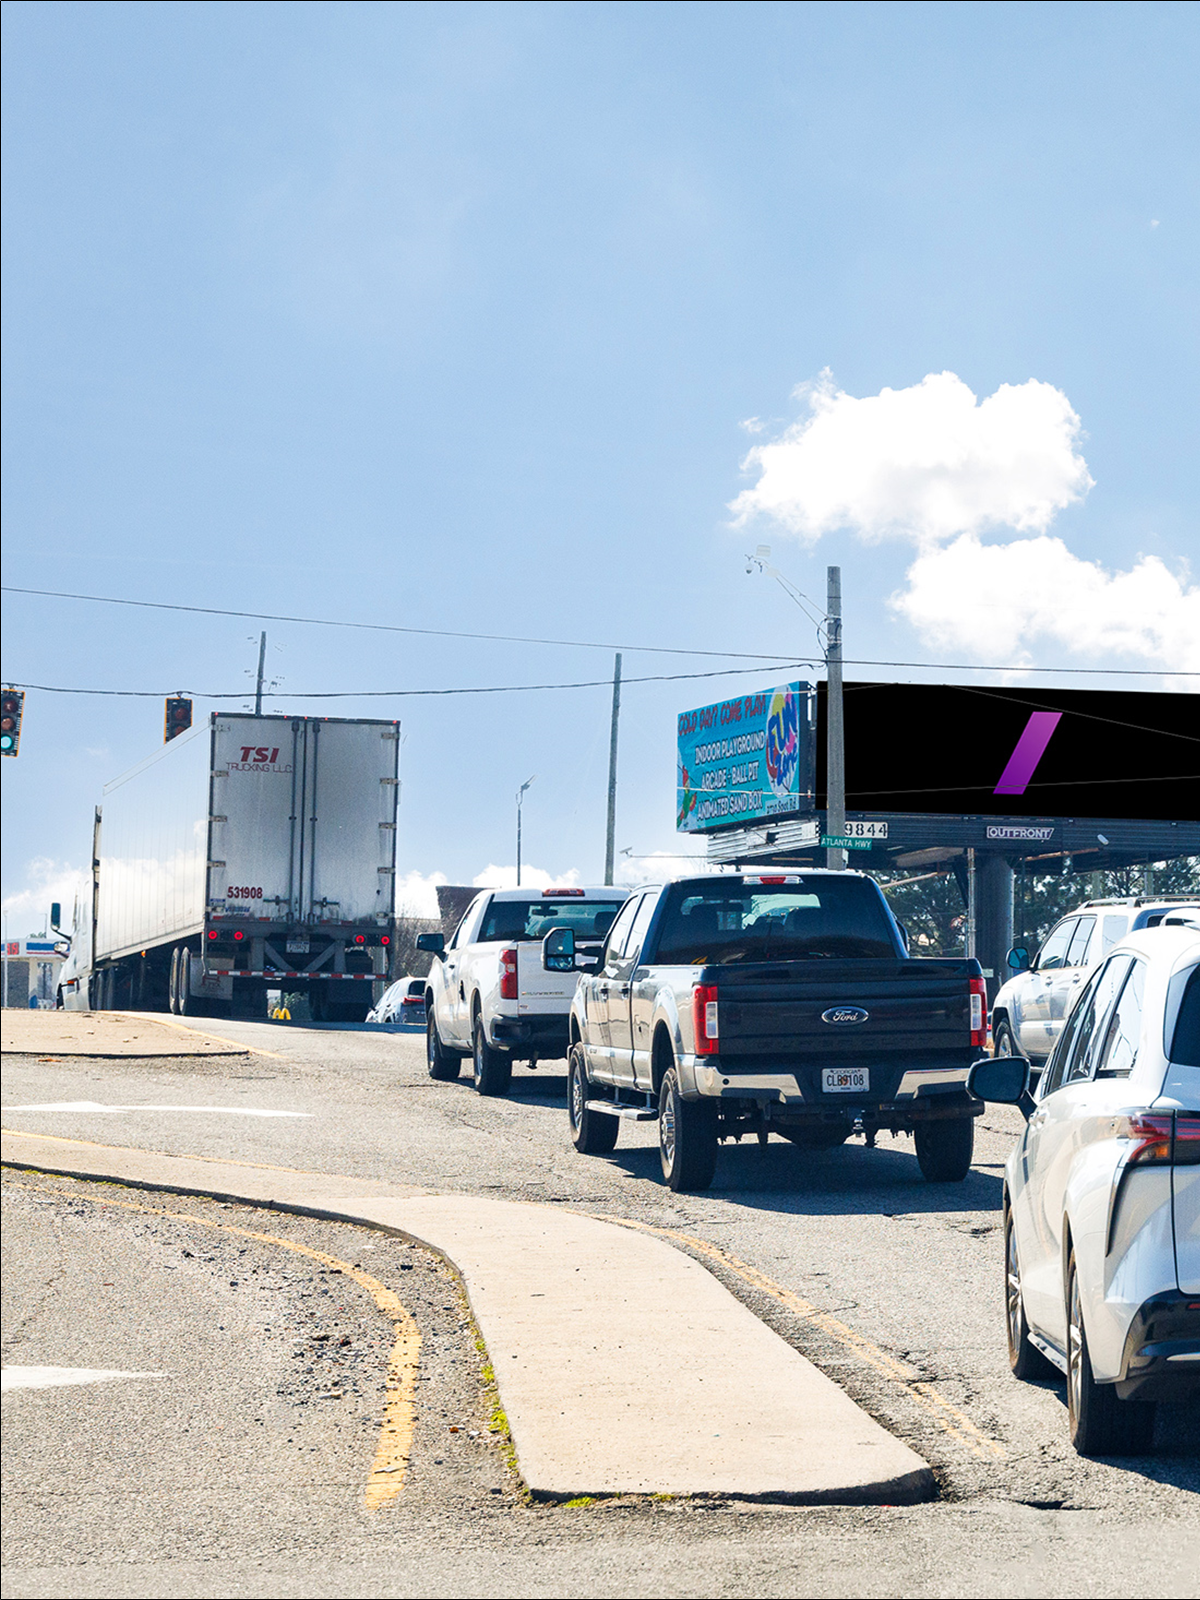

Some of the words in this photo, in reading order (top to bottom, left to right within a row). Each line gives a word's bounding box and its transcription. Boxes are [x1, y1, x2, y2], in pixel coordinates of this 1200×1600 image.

[695, 739, 721, 765] INDOOR
[721, 730, 765, 758] PLAYGROUND
[240, 746, 279, 763] TSI
[226, 762, 270, 772] TRUCKING
[701, 767, 727, 790] ARCADE
[732, 762, 748, 785] BALL
[748, 760, 759, 781] PIT
[697, 796, 729, 821] ANIMATED
[729, 792, 748, 813] SAND
[844, 823, 888, 837] 9844
[989, 827, 1050, 838] OUTFRONT
[821, 838, 853, 847] ATLANTA
[855, 840, 872, 848] HWY
[227, 886, 263, 899] 531908
[832, 1010, 858, 1021] Ford
